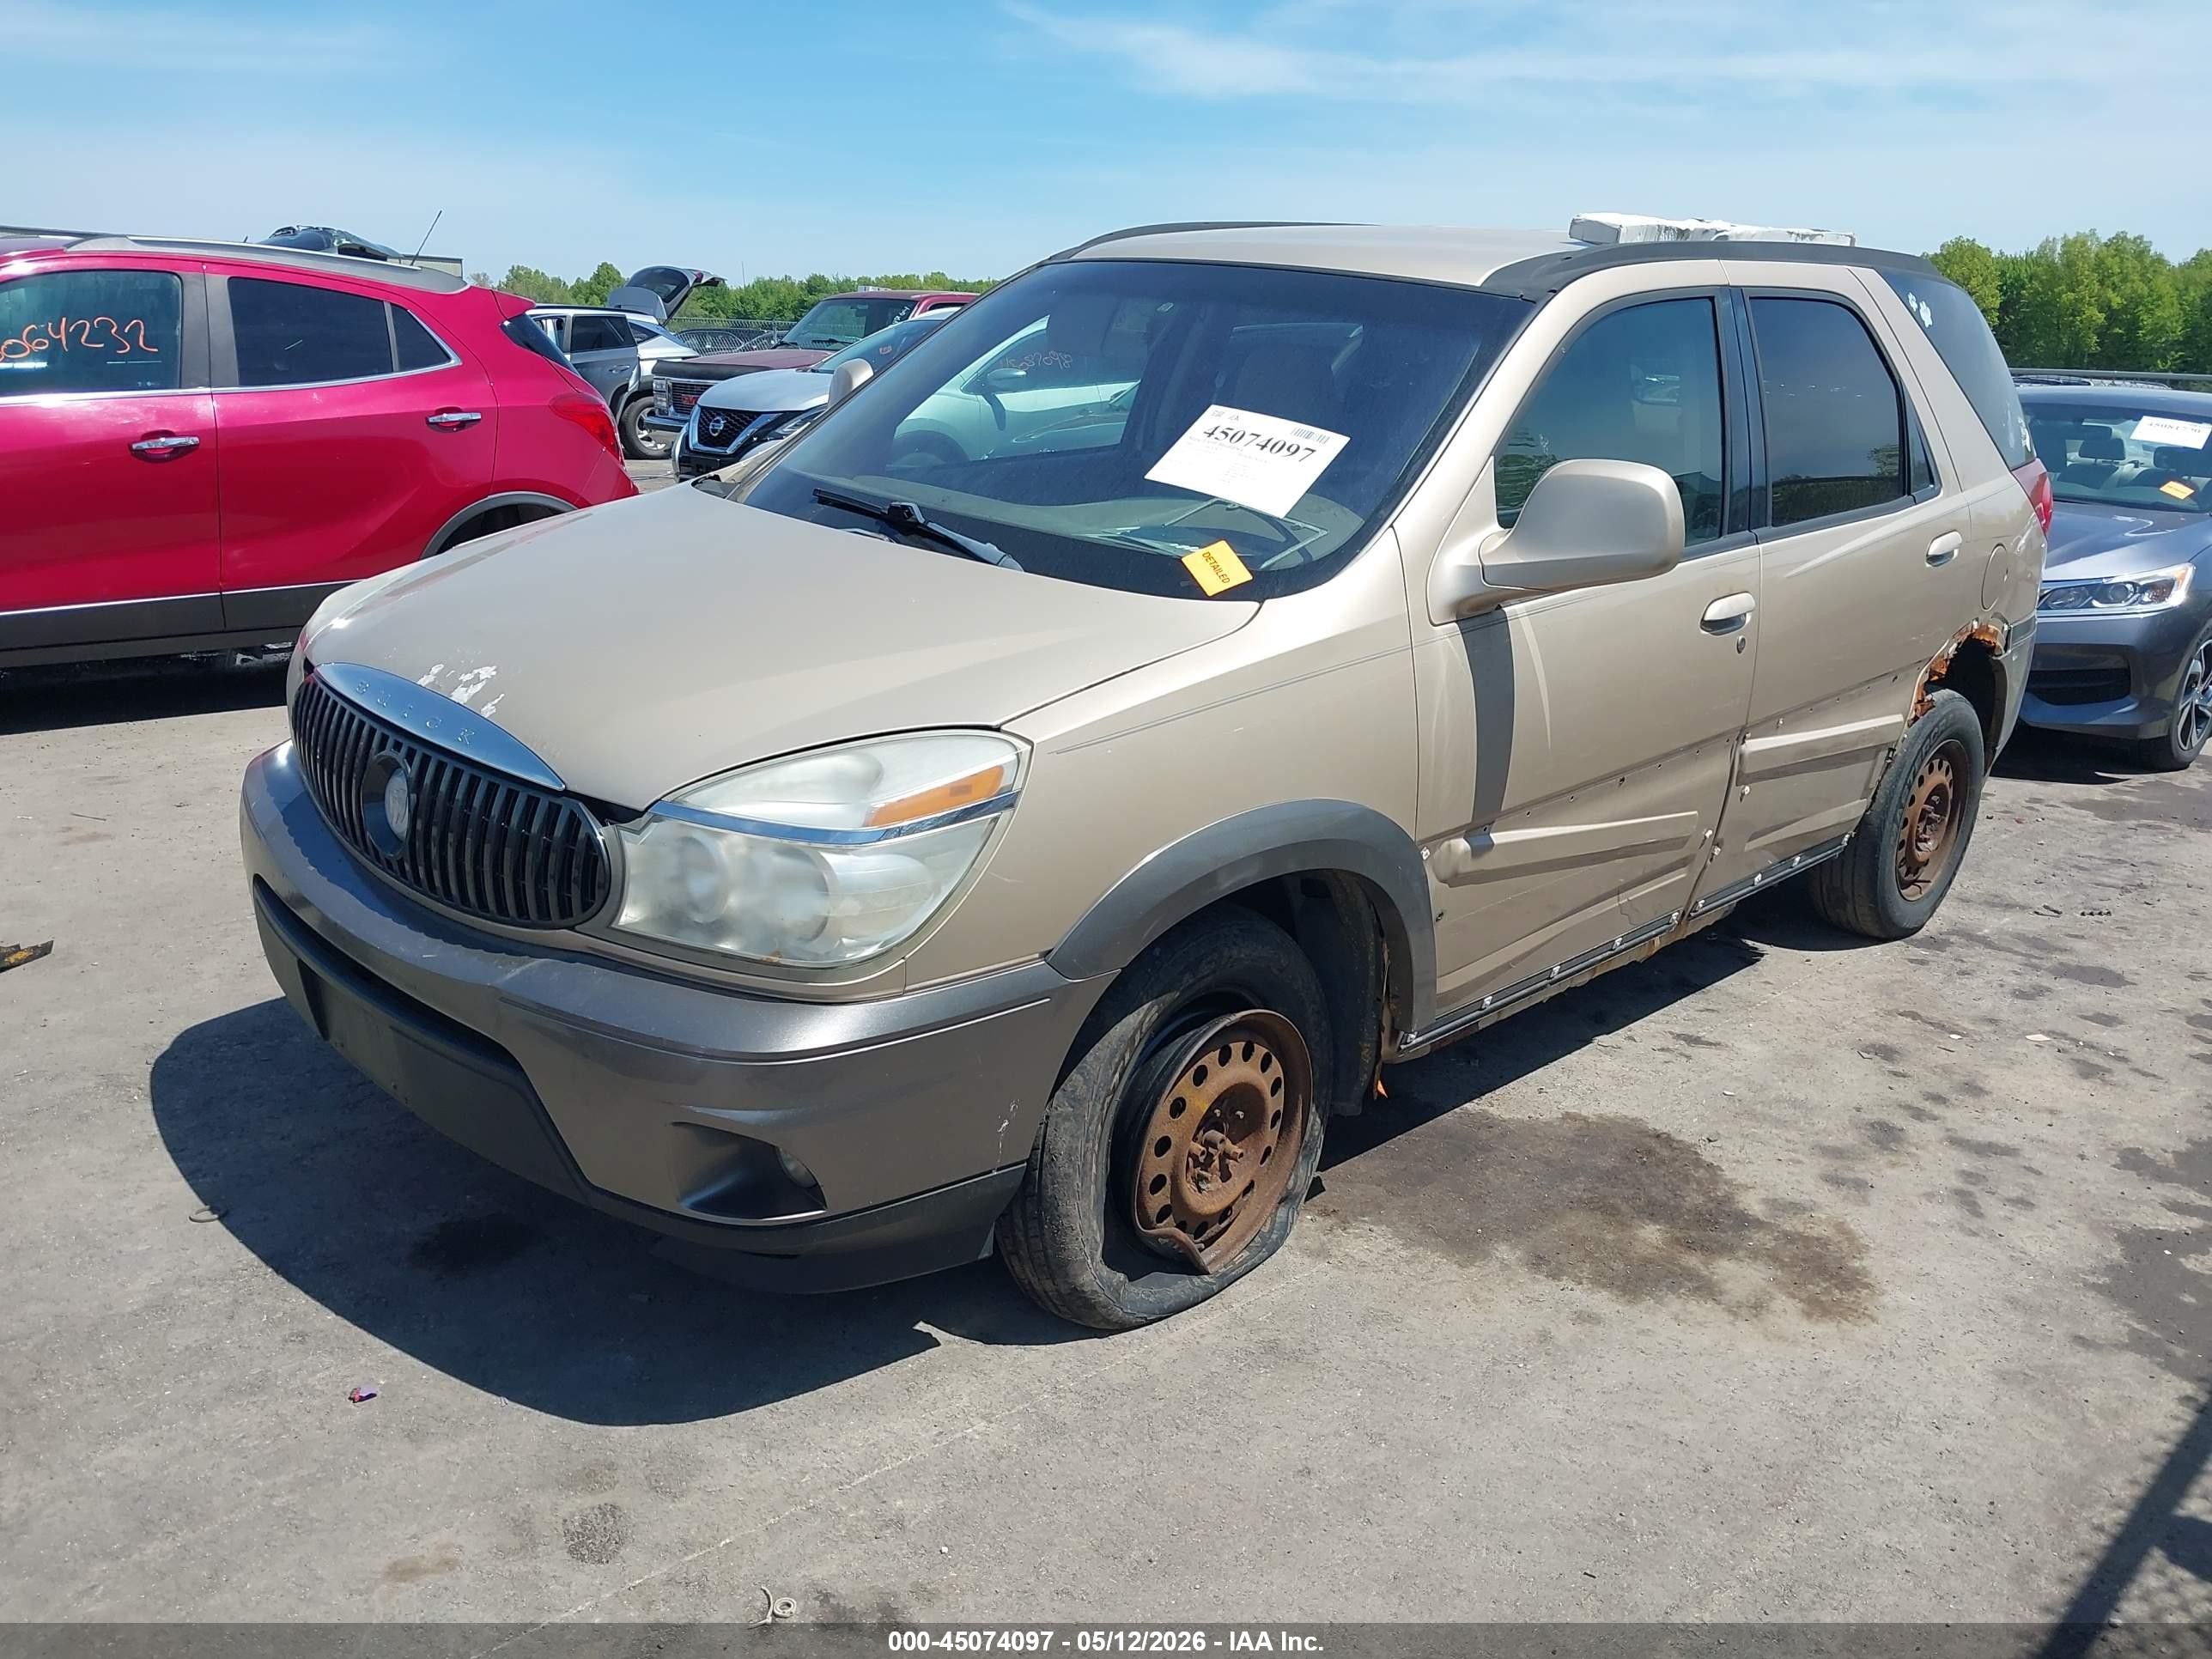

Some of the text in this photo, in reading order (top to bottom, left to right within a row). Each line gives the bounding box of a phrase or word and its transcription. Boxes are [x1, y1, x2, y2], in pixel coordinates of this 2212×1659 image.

[0, 317, 159, 362] 064232
[1203, 425, 1316, 462] 45074097
[1202, 551, 1231, 584] DETAILED
